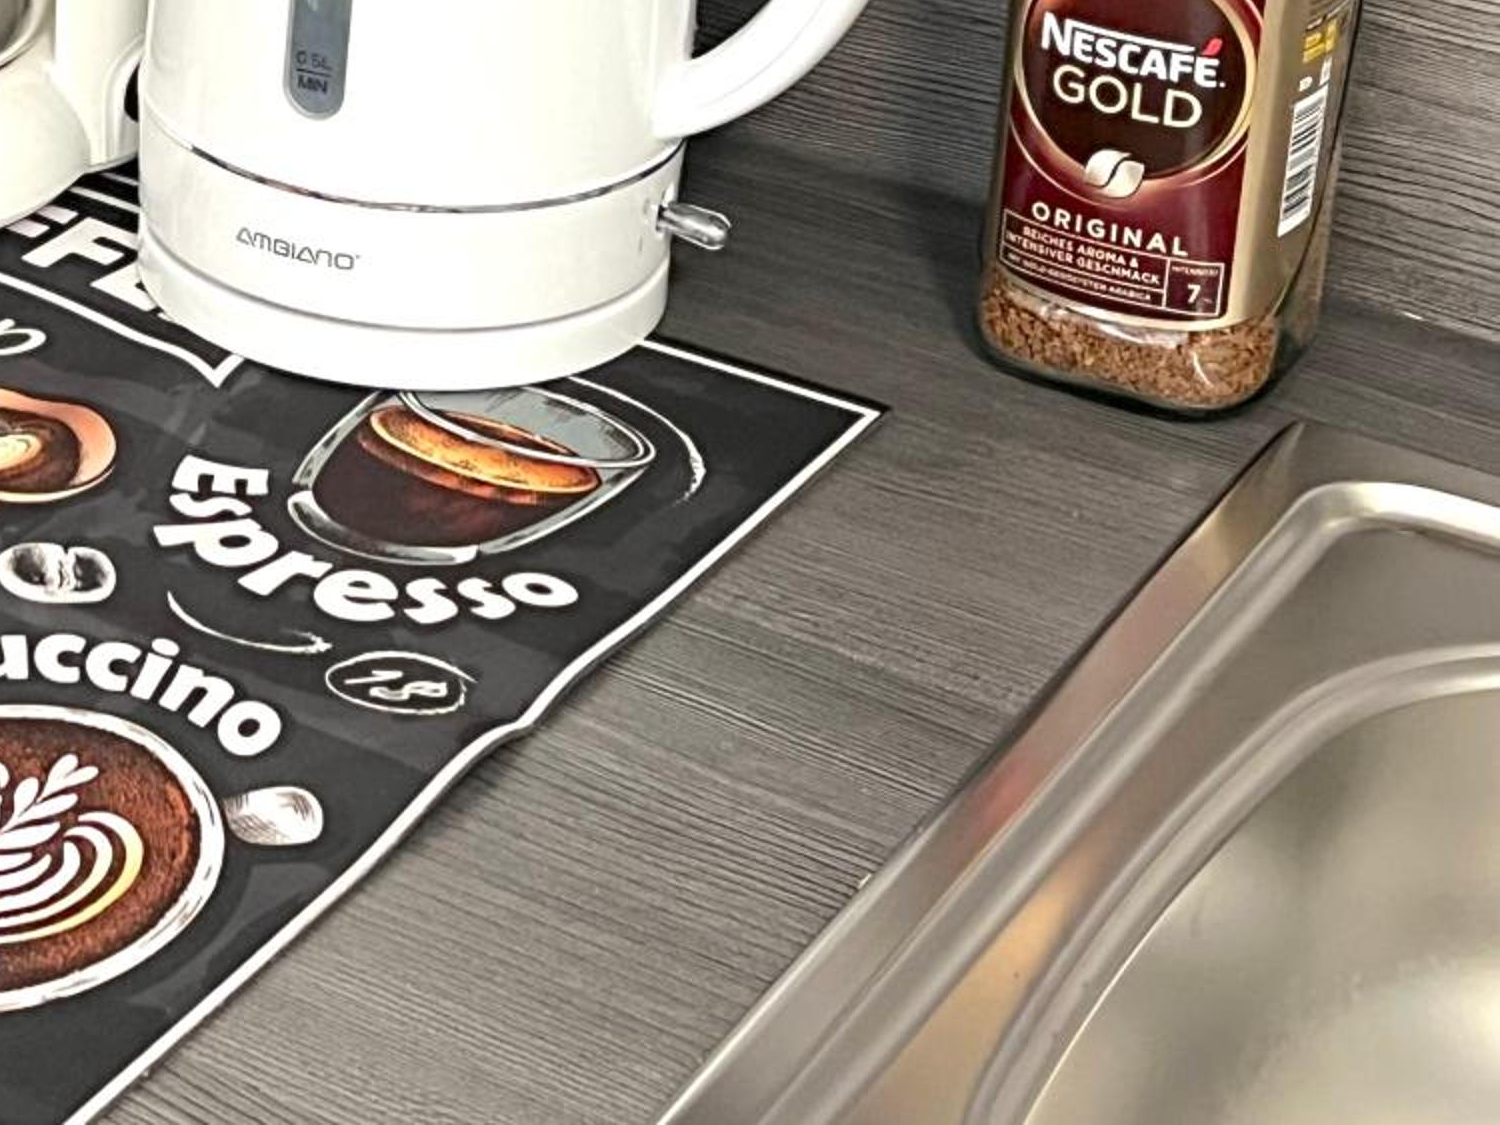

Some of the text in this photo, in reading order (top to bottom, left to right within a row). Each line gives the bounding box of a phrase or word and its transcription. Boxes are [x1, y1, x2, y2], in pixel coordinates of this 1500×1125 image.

[297, 75, 329, 95] MIN
[1052, 63, 1203, 129] GOLD
[1022, 225, 1140, 269] REICHES AROMA &
[1031, 201, 1189, 257] ORIGINAL
[1006, 231, 1074, 265] INTENSIVER
[1075, 255, 1160, 286] GESCHMACK
[1186, 282, 1202, 305] 7
[153, 454, 579, 625] Espresso
